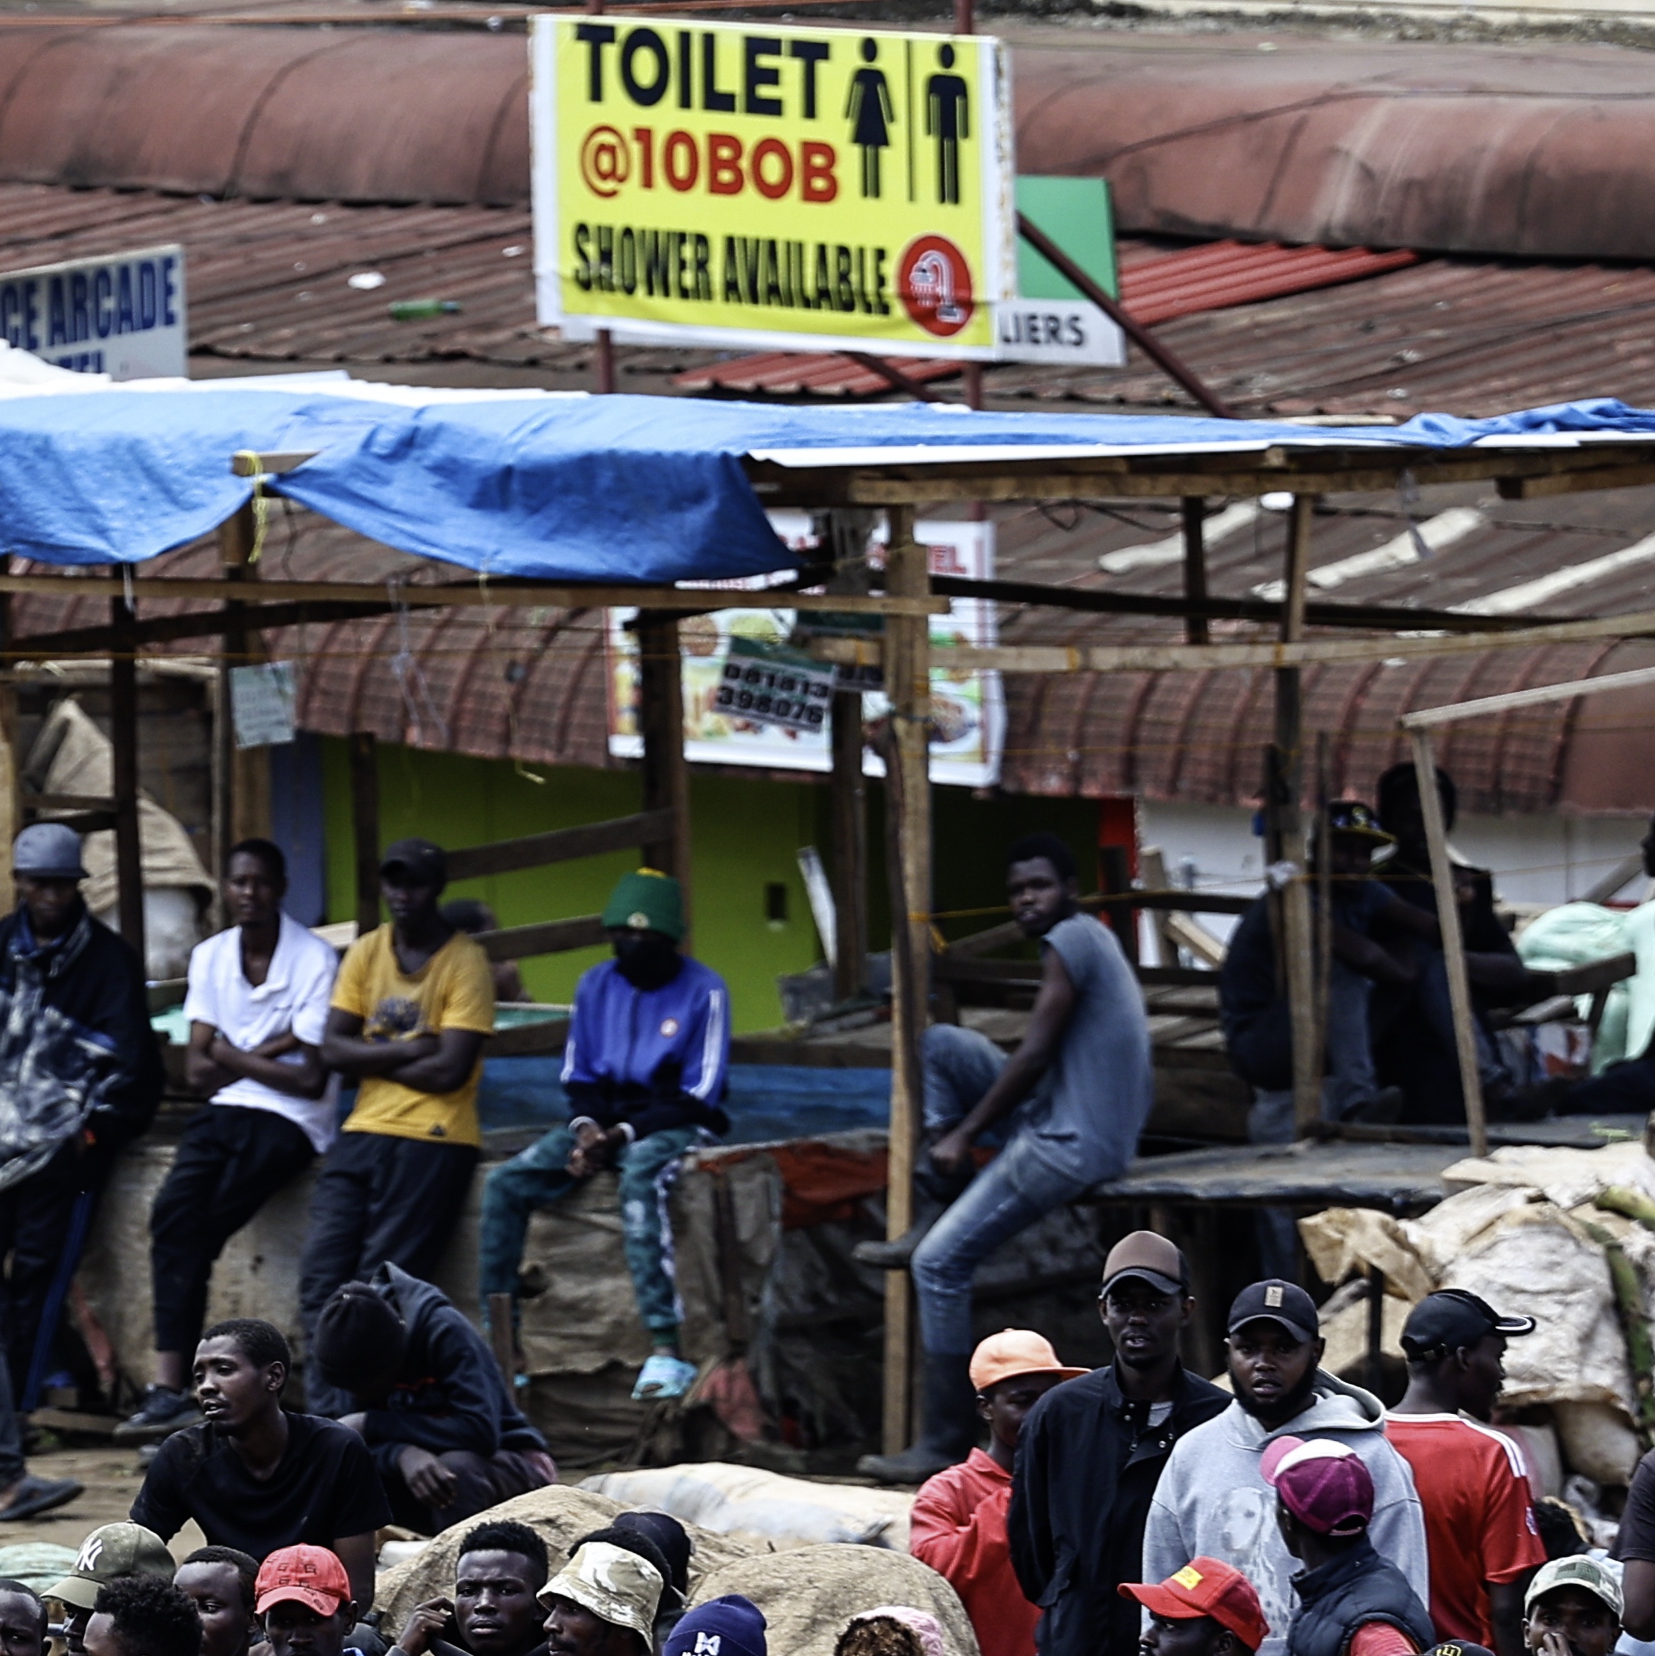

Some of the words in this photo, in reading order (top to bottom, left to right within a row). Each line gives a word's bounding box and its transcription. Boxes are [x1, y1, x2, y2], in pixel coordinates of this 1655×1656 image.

[576, 24, 829, 119] TOILET
[580, 125, 839, 203] @10BOB
[46, 253, 179, 347] ARCADE
[574, 222, 712, 301] SHOWER
[723, 235, 891, 315] AVAILABLE
